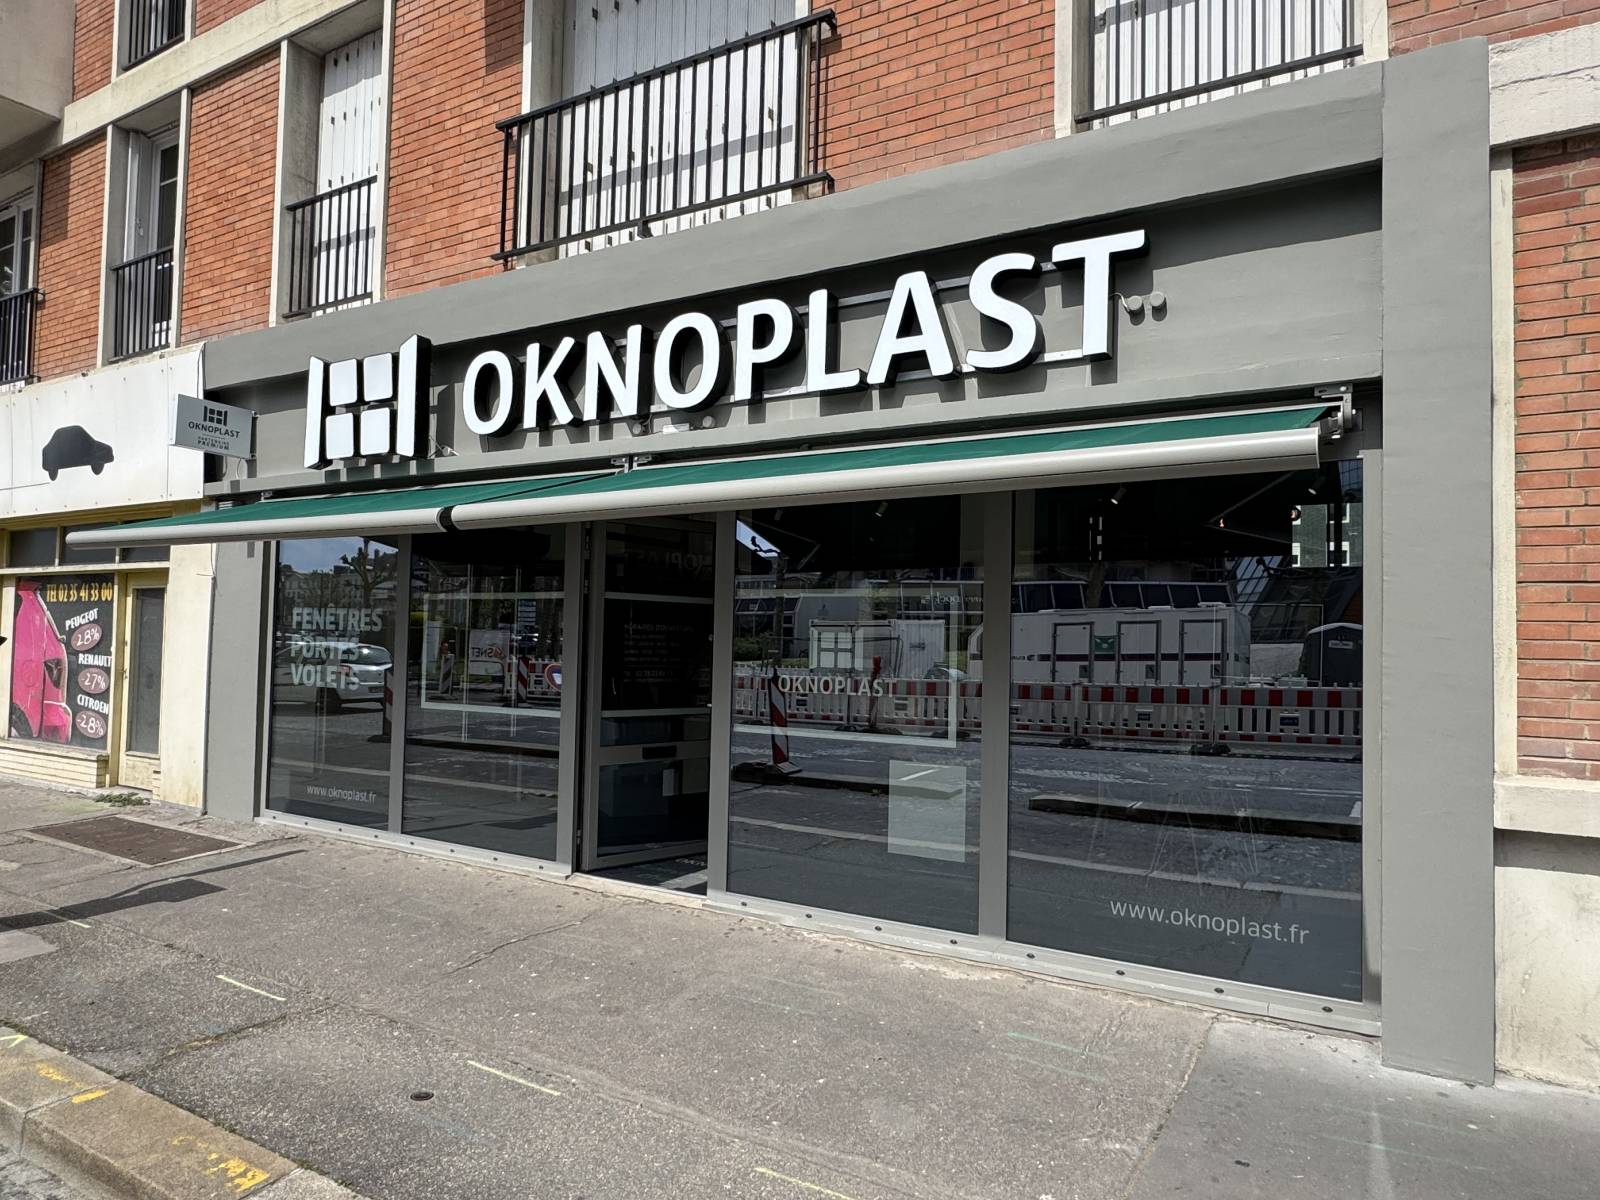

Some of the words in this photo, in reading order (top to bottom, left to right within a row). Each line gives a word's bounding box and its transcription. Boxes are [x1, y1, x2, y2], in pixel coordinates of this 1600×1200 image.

[462, 229, 1147, 437] OKNOPLAST
[188, 421, 240, 439] OKNOPLAST
[58, 583, 68, 602] 02
[69, 583, 78, 602] 35
[80, 583, 89, 602] 41
[91, 582, 99, 602] 33
[101, 582, 113, 602] 00
[65, 608, 98, 631] PEUGEOT
[292, 603, 383, 631] FENÊTRES
[290, 635, 360, 660] PORTES
[78, 653, 112, 667] RENAULT
[81, 672, 106, 690] -27%
[290, 663, 360, 691] VOLETS
[778, 674, 898, 698] OKNOPLAST
[77, 694, 109, 715] CITROEN
[77, 714, 104, 736] -28%
[306, 785, 377, 805] www.oknoplast.fr
[1110, 900, 1311, 945] www.oknoplast.fr
